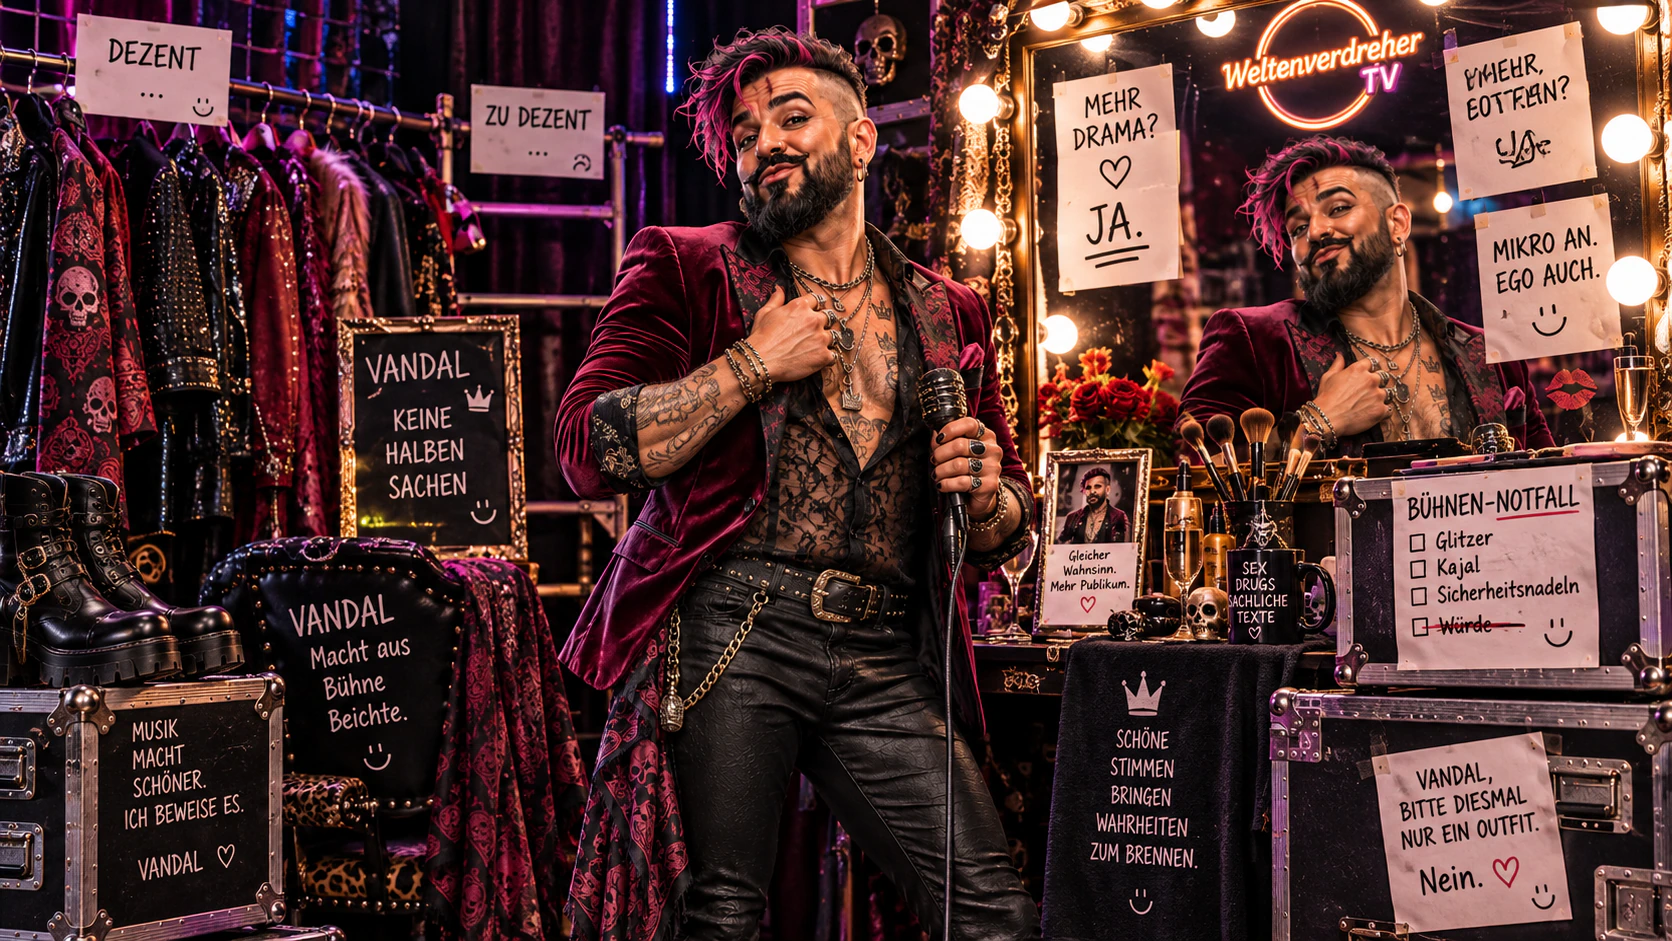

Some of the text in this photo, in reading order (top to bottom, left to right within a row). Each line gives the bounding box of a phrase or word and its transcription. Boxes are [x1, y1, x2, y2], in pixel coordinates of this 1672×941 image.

[108, 38, 201, 71] DEZENT
[1221, 28, 1424, 92] Weltenverdreher
[1359, 60, 1403, 95] TV
[1085, 87, 1142, 118] MEHR
[485, 105, 592, 131] ZU DEZENT
[1073, 113, 1158, 150] DRAMA?
[1086, 202, 1143, 245] JA.
[1493, 225, 1598, 263] MIKRO AN.
[1496, 256, 1600, 294] EGO AUCH.
[365, 350, 470, 384] VANDAL
[393, 406, 452, 432] KEINE
[386, 438, 464, 464] HALBEN
[389, 471, 467, 499] SACHEN
[1407, 484, 1580, 521] BÜHNEN-NOTFALL
[1436, 530, 1493, 551] Glitzer
[1068, 549, 1111, 562] Gleicher
[1242, 561, 1267, 575] SEX
[1437, 555, 1481, 580] Kajal
[1063, 564, 1117, 576] Wahnsinn.
[1050, 578, 1130, 592] Mehr Publikum.
[1235, 578, 1276, 591] DRUGS
[1437, 575, 1580, 604] Sicherheitsnadeln
[288, 593, 394, 637] VANDAL
[1228, 594, 1288, 608] SACHLICHE
[1237, 610, 1275, 624] TEXTE
[1438, 615, 1493, 635] Würde
[310, 638, 411, 670] Macht aus
[323, 673, 386, 700] Bühne
[132, 718, 179, 743] MUSIK
[328, 702, 408, 733] Beichte.
[1116, 726, 1170, 750] SCHÖNE
[132, 744, 185, 770] MACHT
[1110, 757, 1175, 778] STIMMEN
[133, 770, 207, 798] SCHÖNER.
[1416, 762, 1493, 791] VANDAL,
[1111, 785, 1172, 807] BRINGEN
[1399, 785, 1528, 822] BITTE DIESMAL
[124, 793, 245, 830] ICH BEWEISE ES.
[1096, 812, 1189, 837] WAHRHEITEN
[1400, 811, 1540, 850] NUR EIN OUTFIT.
[137, 850, 204, 881] VANDAL
[1090, 842, 1199, 870] ZUM BRENNEN.
[1419, 865, 1484, 896] Nein.
